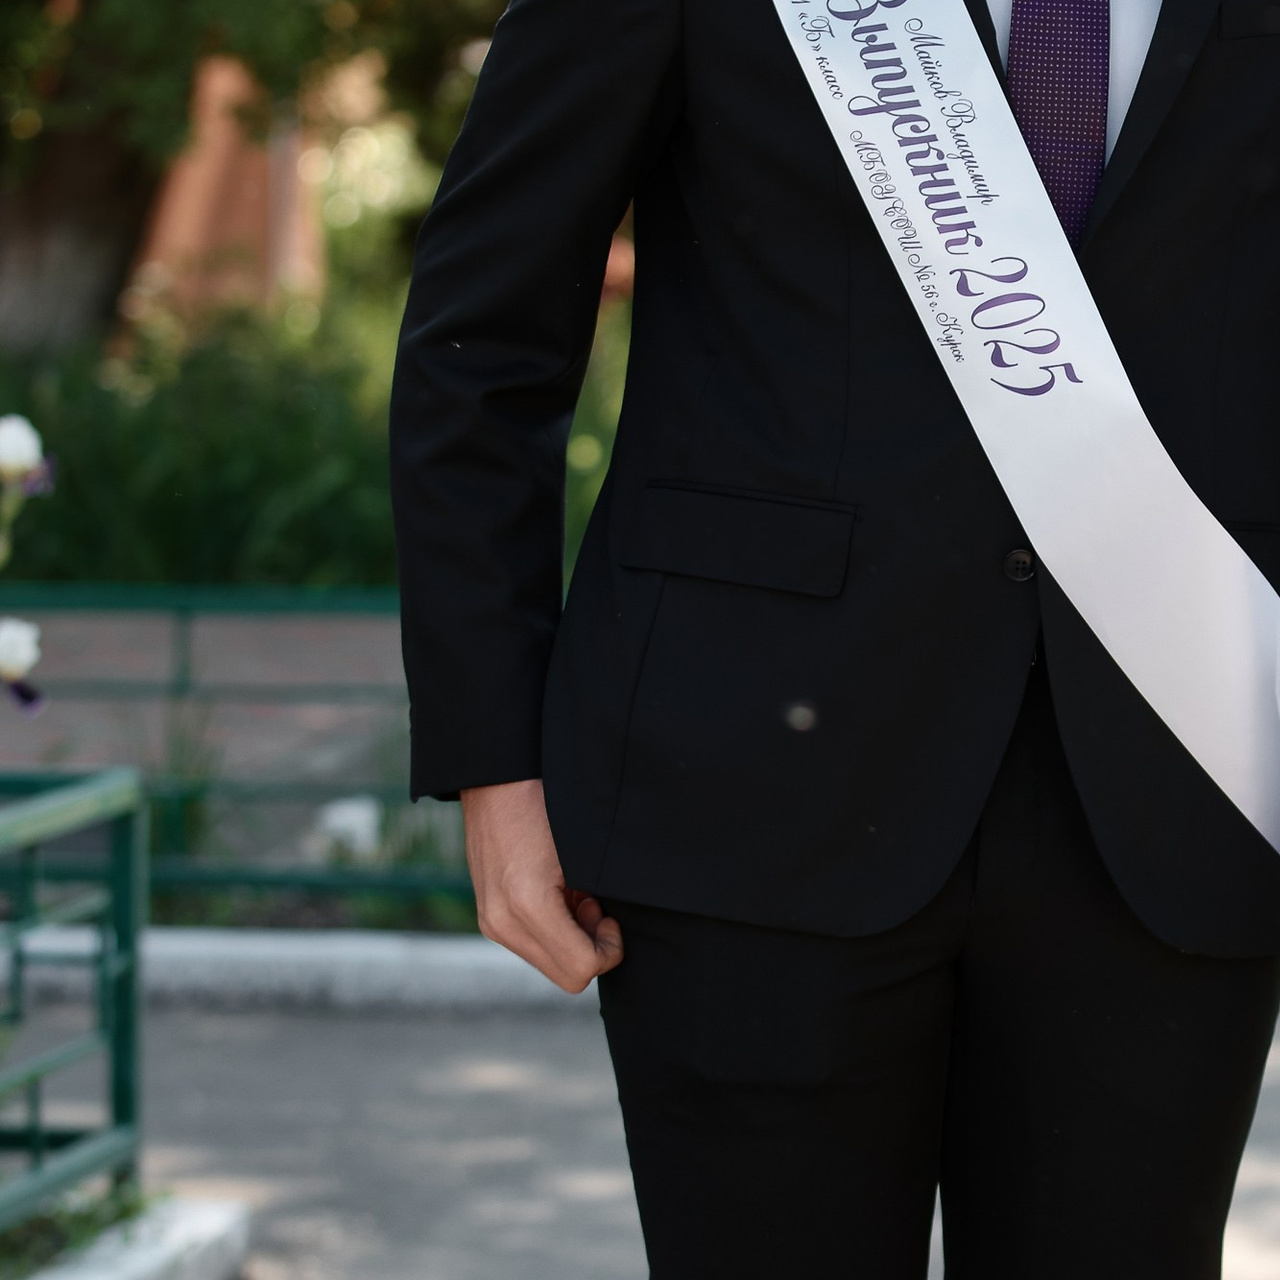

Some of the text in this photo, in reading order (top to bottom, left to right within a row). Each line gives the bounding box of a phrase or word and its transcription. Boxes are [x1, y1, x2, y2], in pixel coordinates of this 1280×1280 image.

[815, 57, 844, 100] класс
[903, 17, 1000, 205] Майков Владимир
[920, 284, 939, 299] 56
[936, 313, 965, 363] Курск
[949, 257, 1084, 397] 2025
